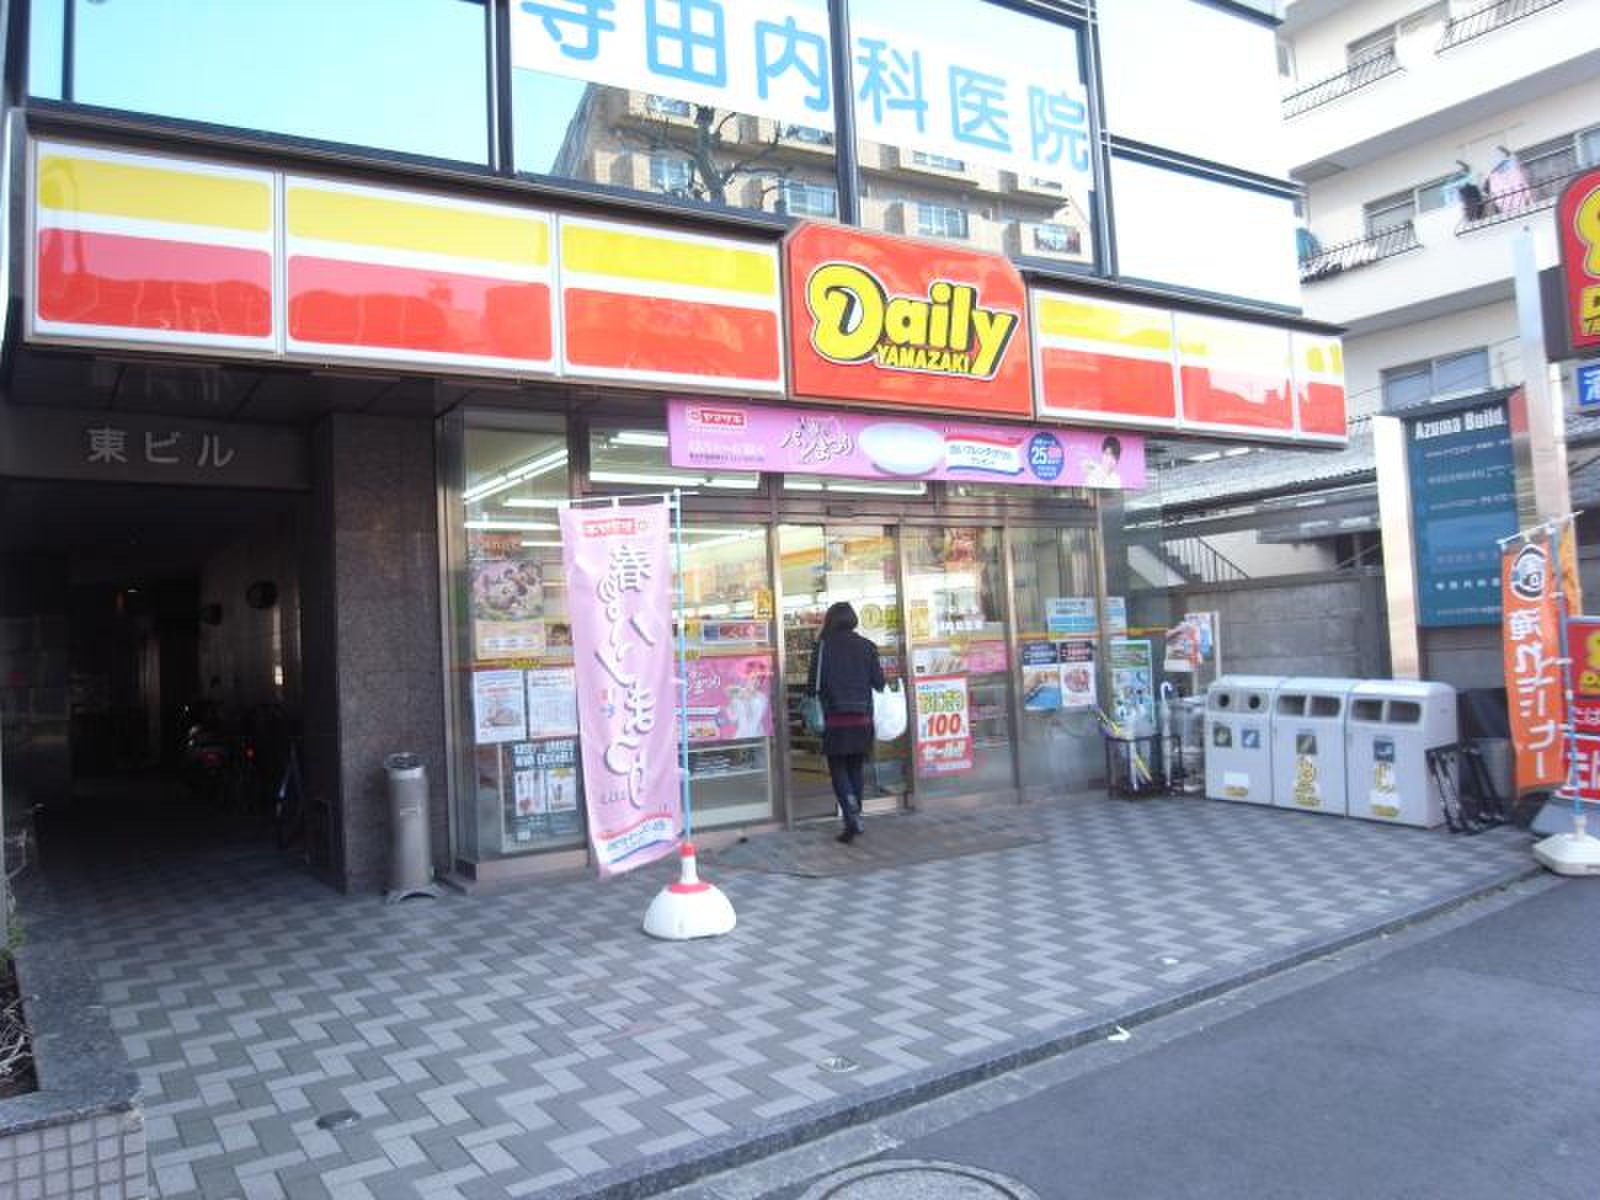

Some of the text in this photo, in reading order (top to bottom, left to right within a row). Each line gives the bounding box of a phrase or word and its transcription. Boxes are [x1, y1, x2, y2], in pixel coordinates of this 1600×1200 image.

[808, 263, 1018, 377] Daily
[877, 345, 969, 373] YAMAZAKI
[1415, 418, 1461, 440] Azuma
[87, 427, 236, 467] 東ビル
[928, 713, 961, 737] 100
